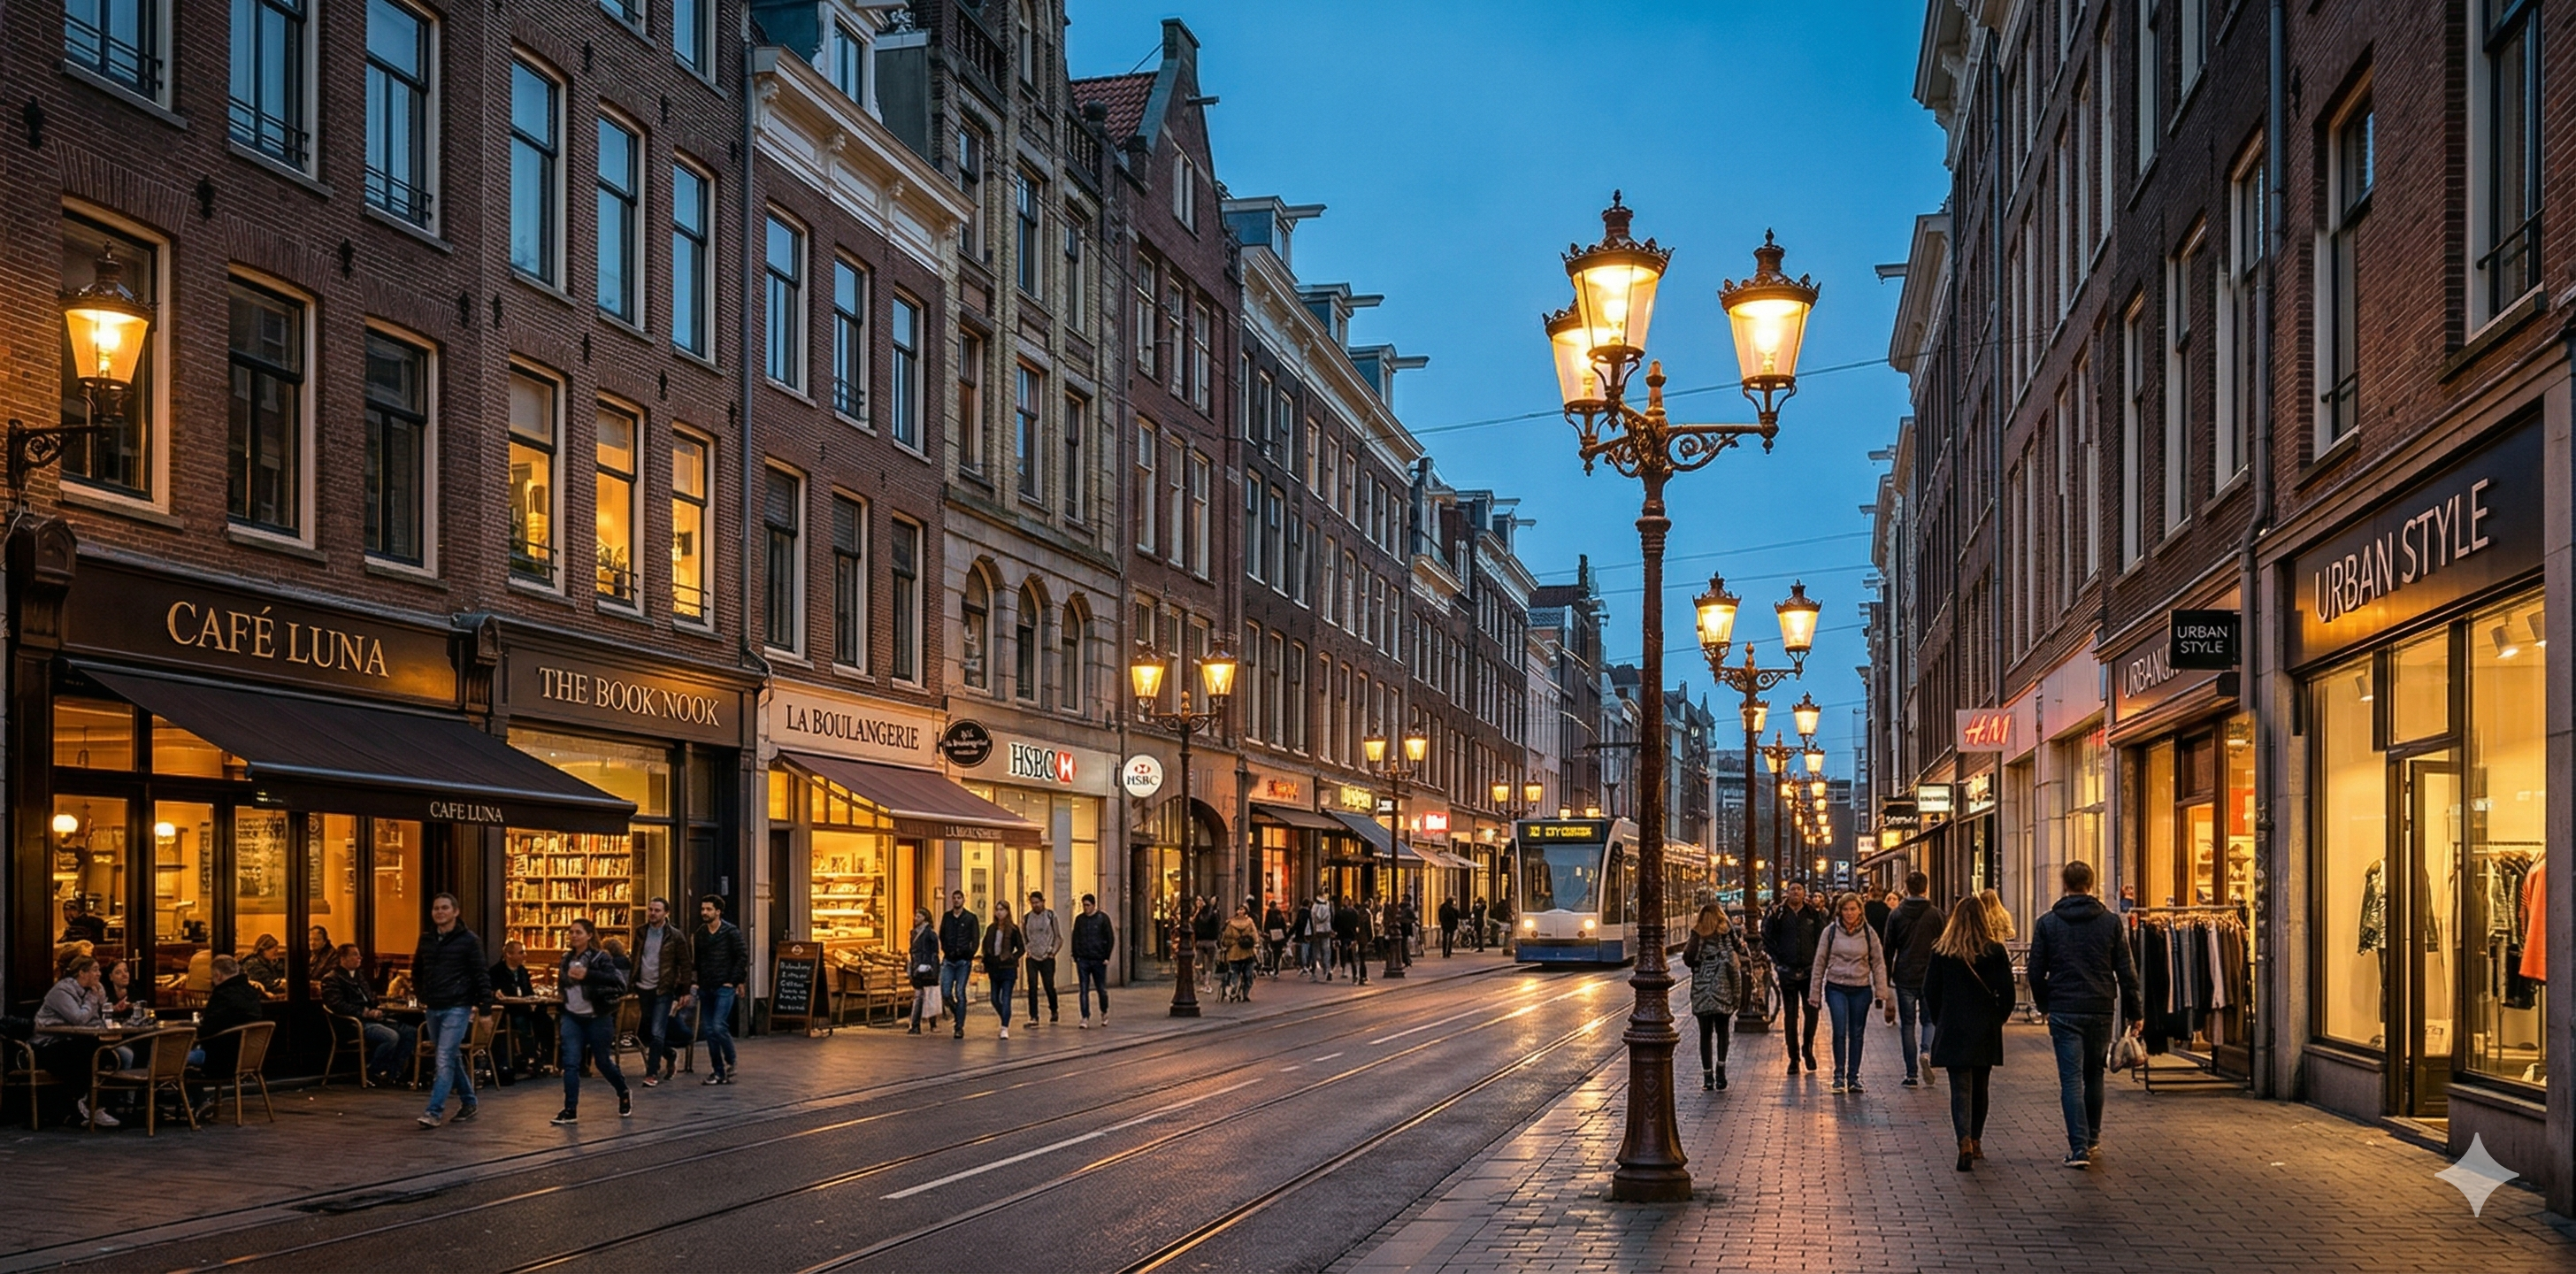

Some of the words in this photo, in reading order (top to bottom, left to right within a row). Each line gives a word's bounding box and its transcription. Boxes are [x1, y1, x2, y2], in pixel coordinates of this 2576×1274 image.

[2314, 532, 2393, 624] URBAN
[2401, 478, 2489, 584] STYLE
[166, 601, 275, 659] CAFÉ
[285, 620, 390, 678] LUNA
[2177, 625, 2228, 639] URBAN
[2180, 641, 2224, 654] STYLE
[2123, 648, 2161, 699] URBAN
[538, 667, 589, 705] THE
[594, 676, 657, 717] BOOK
[661, 689, 722, 728] NOOK
[786, 704, 809, 733] LA
[812, 709, 920, 751] BOULANGERIE
[1010, 743, 1056, 779] HSBC
[1126, 775, 1160, 786] HSBC
[429, 801, 466, 820] CAFE
[467, 804, 504, 823] LUNA
